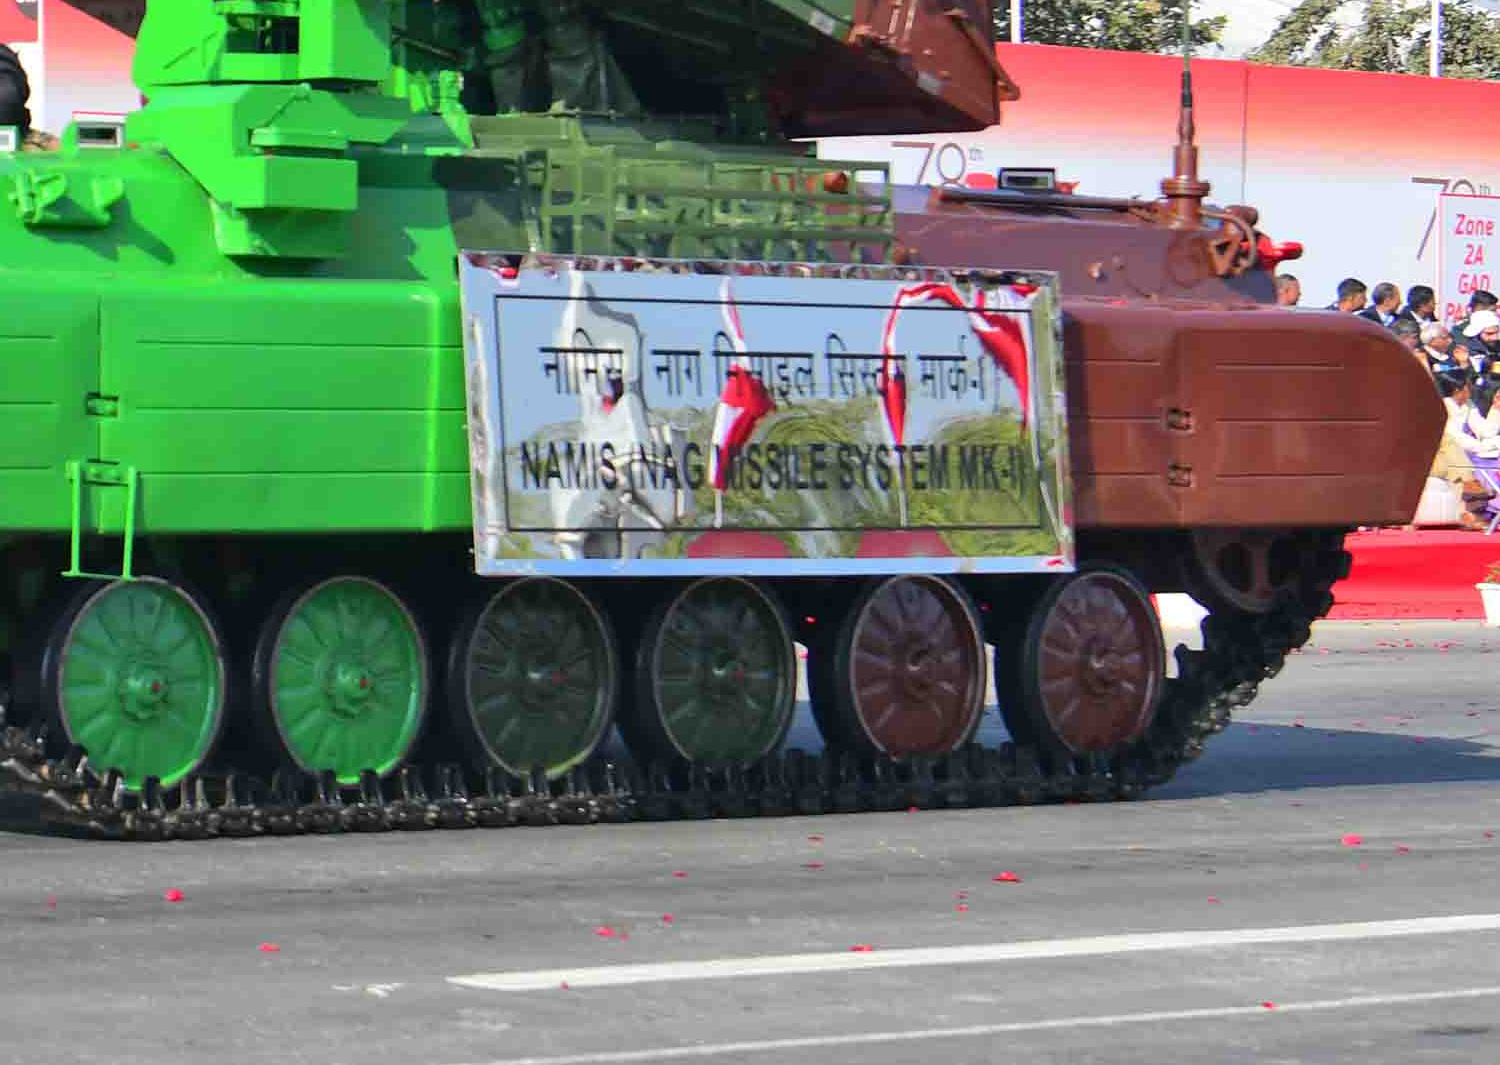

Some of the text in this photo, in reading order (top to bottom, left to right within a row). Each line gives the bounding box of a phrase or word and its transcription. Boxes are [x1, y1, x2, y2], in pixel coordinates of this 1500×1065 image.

[1454, 213, 1496, 236] Zone
[1464, 243, 1484, 265] 2A
[521, 441, 617, 490] NAMIS
[713, 442, 828, 490] MISSILE
[837, 443, 951, 490] SYSTEM
